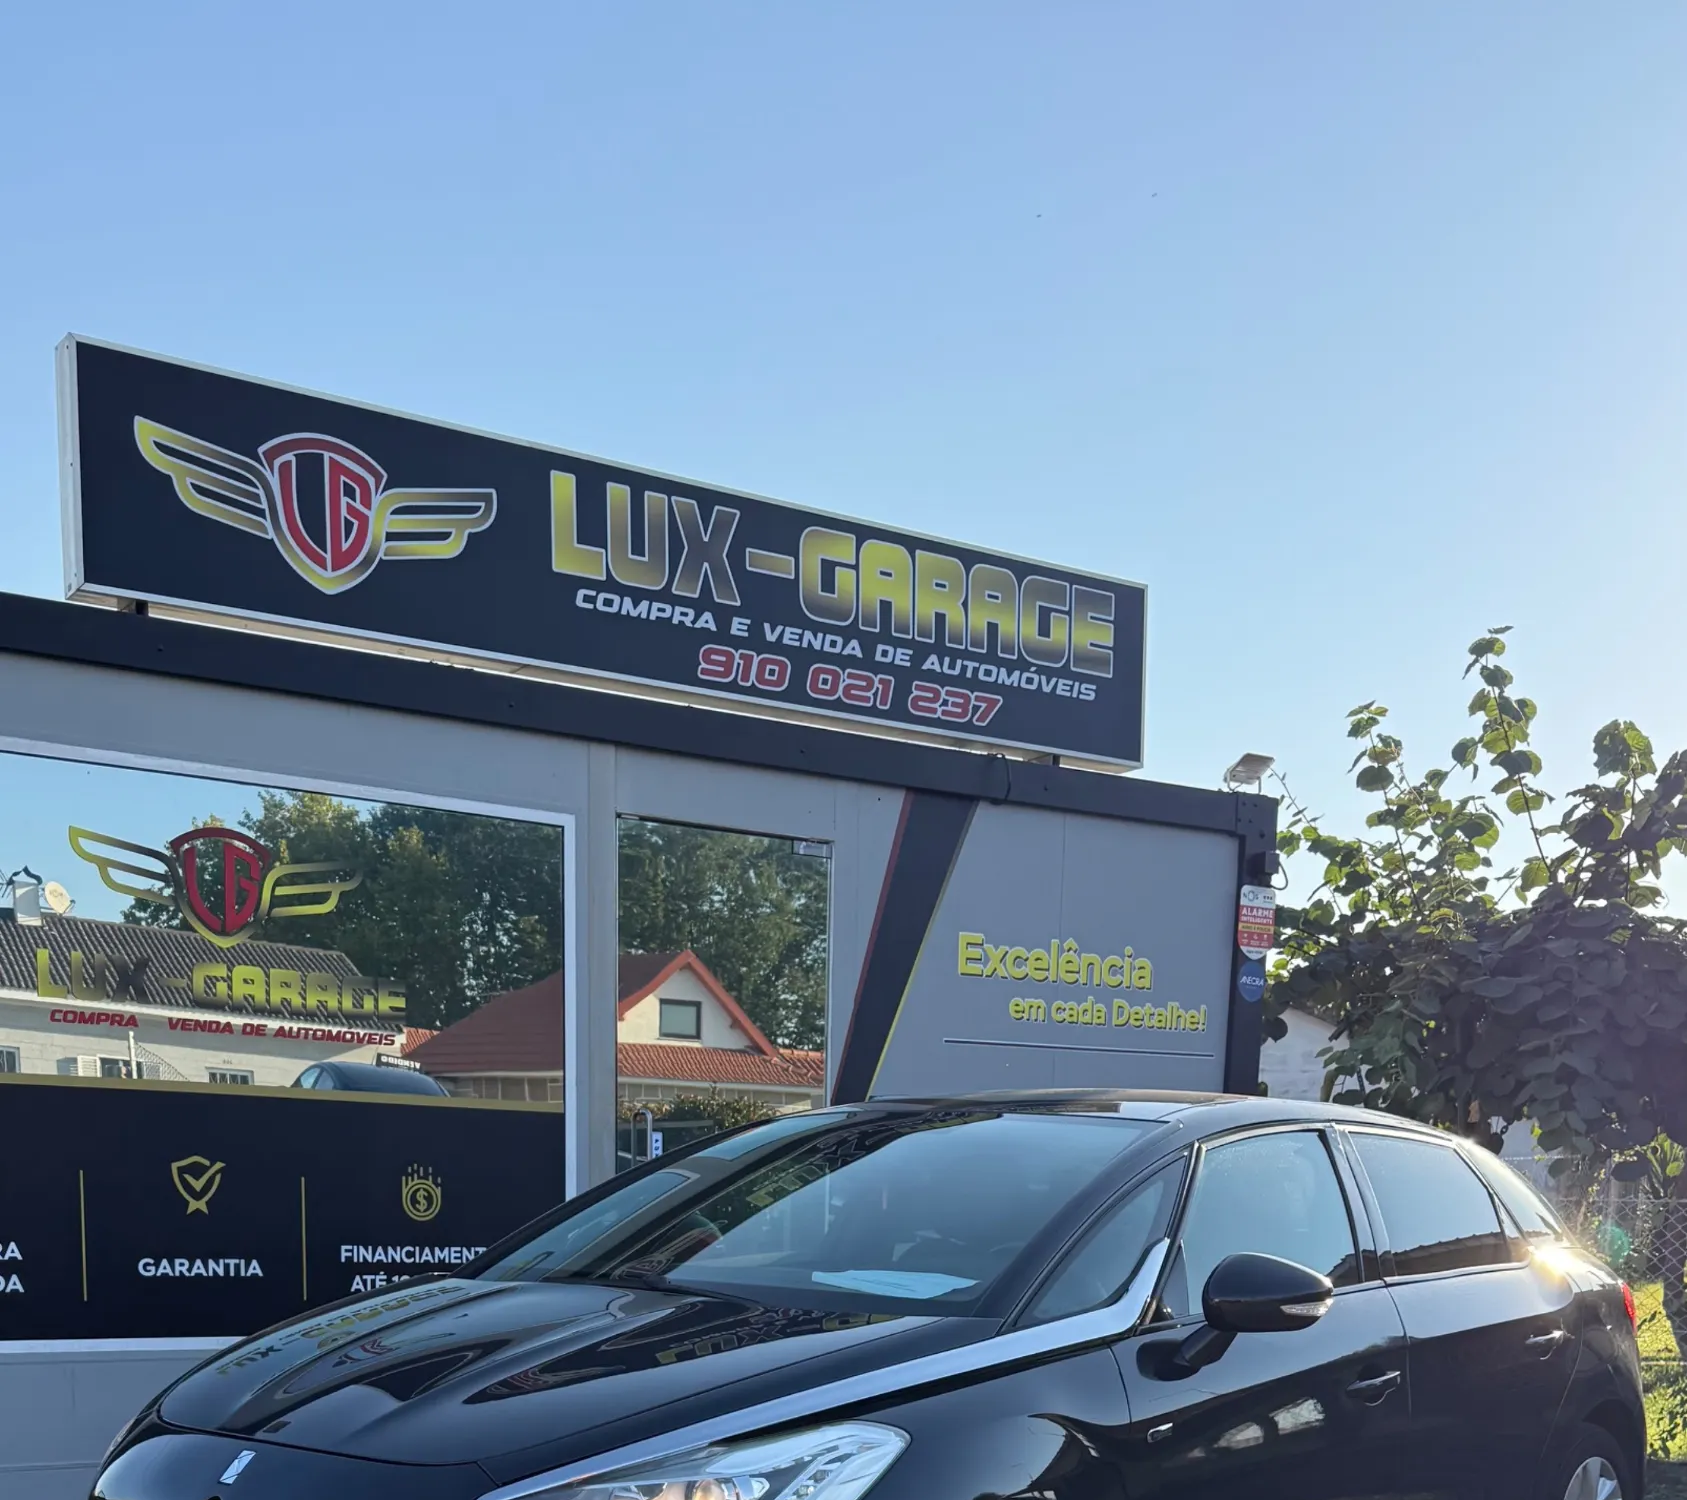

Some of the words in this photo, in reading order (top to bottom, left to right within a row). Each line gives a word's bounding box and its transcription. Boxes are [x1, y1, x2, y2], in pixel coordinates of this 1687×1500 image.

[550, 469, 1115, 678] LUX-GARAGE
[575, 588, 717, 632] COMPRA
[730, 616, 751, 637] E
[763, 622, 863, 658] VENDA
[874, 643, 914, 667] DE
[921, 653, 1097, 701] AUTOMÓVEIS
[698, 643, 791, 691] 910
[806, 663, 895, 710] 021
[908, 680, 1003, 727] 237
[1241, 907, 1273, 918] ALARME
[36, 948, 407, 1023] LUX-GARAGE
[957, 932, 1153, 991] Excelência
[49, 1008, 139, 1028] COMPRA
[167, 1017, 234, 1035] VENDA
[241, 1021, 268, 1037] DE
[1009, 996, 1047, 1023] em
[1051, 995, 1107, 1027] cada
[1112, 998, 1207, 1033] Detalhe!
[137, 1257, 264, 1277] GARANTIA
